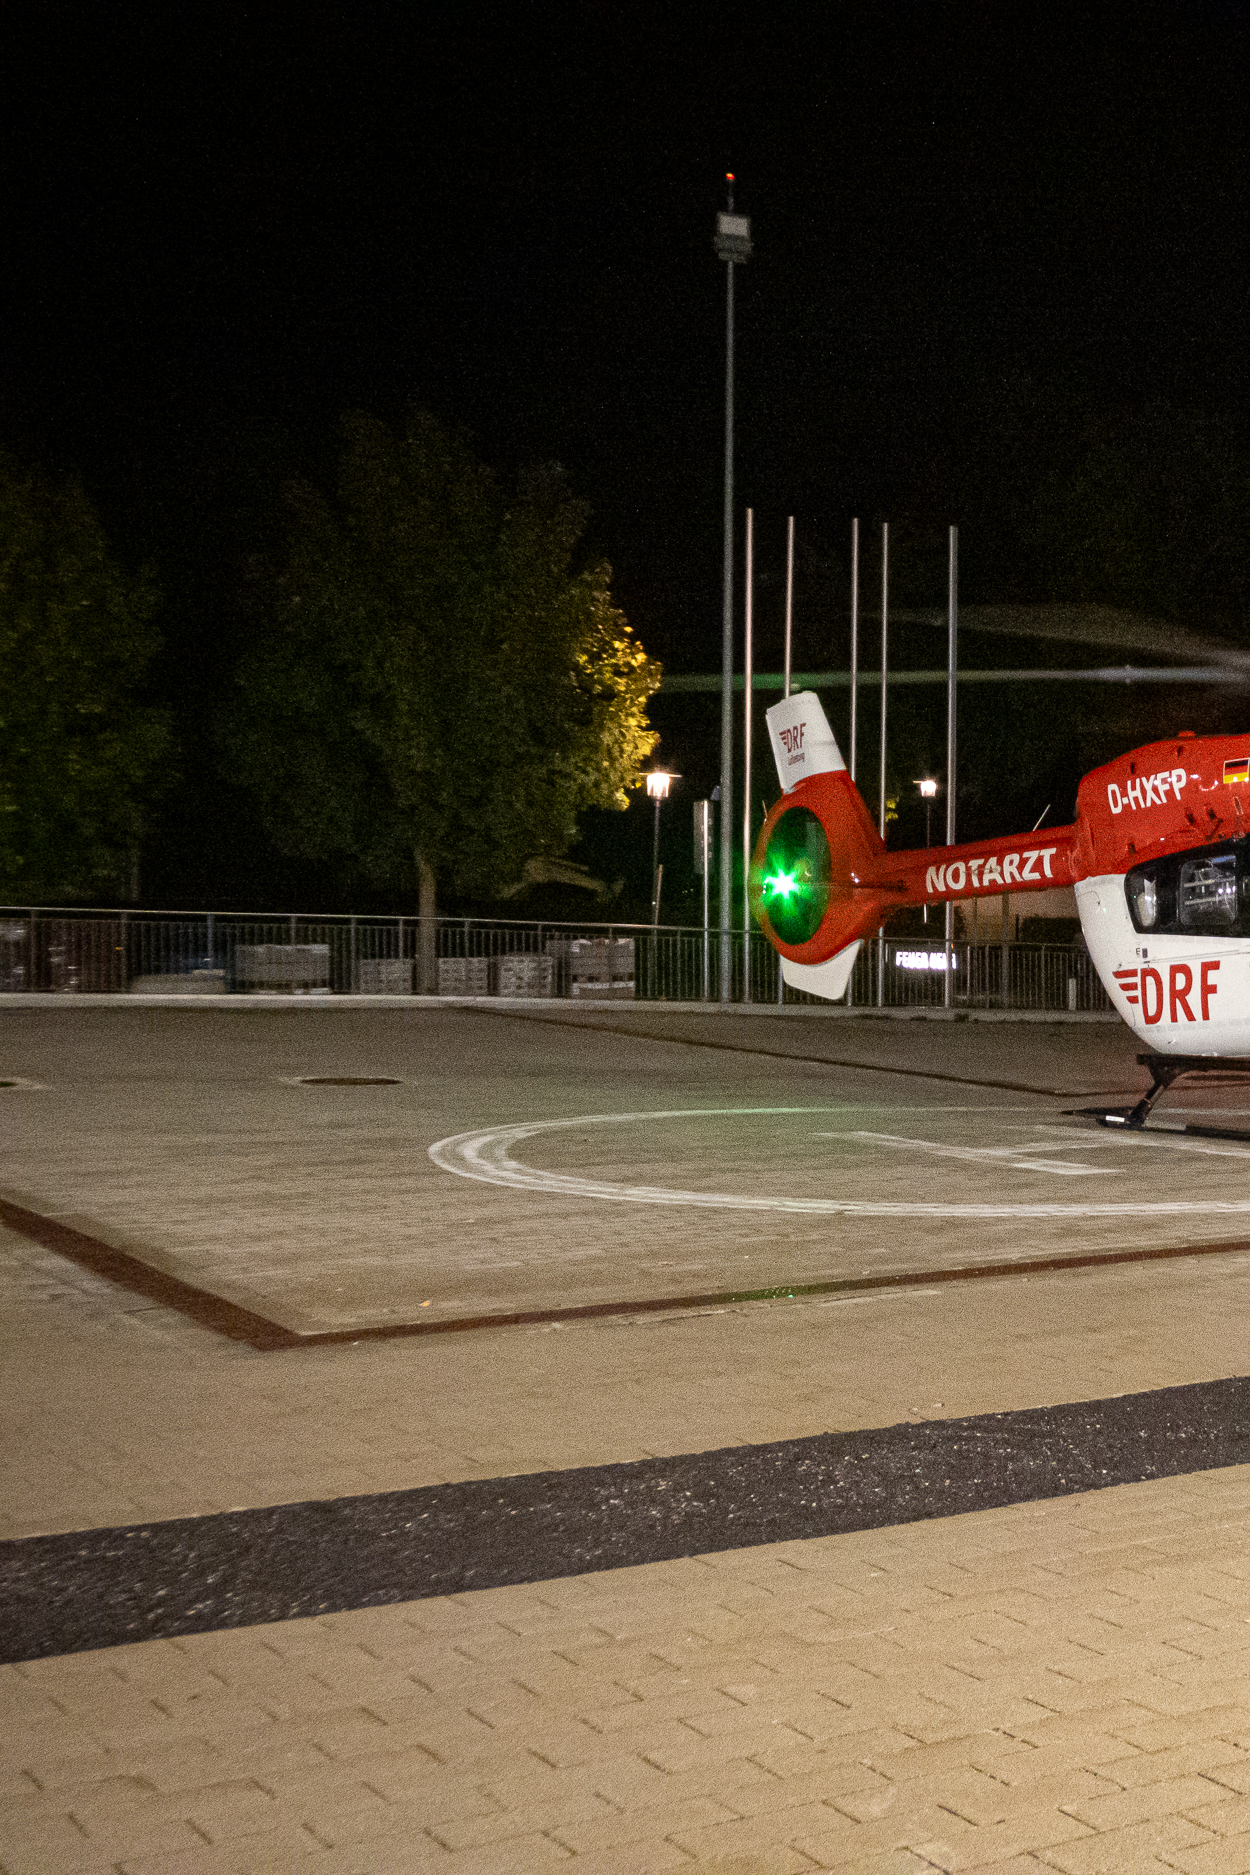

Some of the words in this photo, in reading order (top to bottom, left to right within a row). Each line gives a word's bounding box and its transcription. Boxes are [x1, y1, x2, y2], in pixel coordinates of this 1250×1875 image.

[786, 723, 806, 753] DRF
[1107, 768, 1187, 815] D-HXFP
[925, 848, 1057, 893] NOTARZT
[1140, 960, 1221, 1025] DRF
